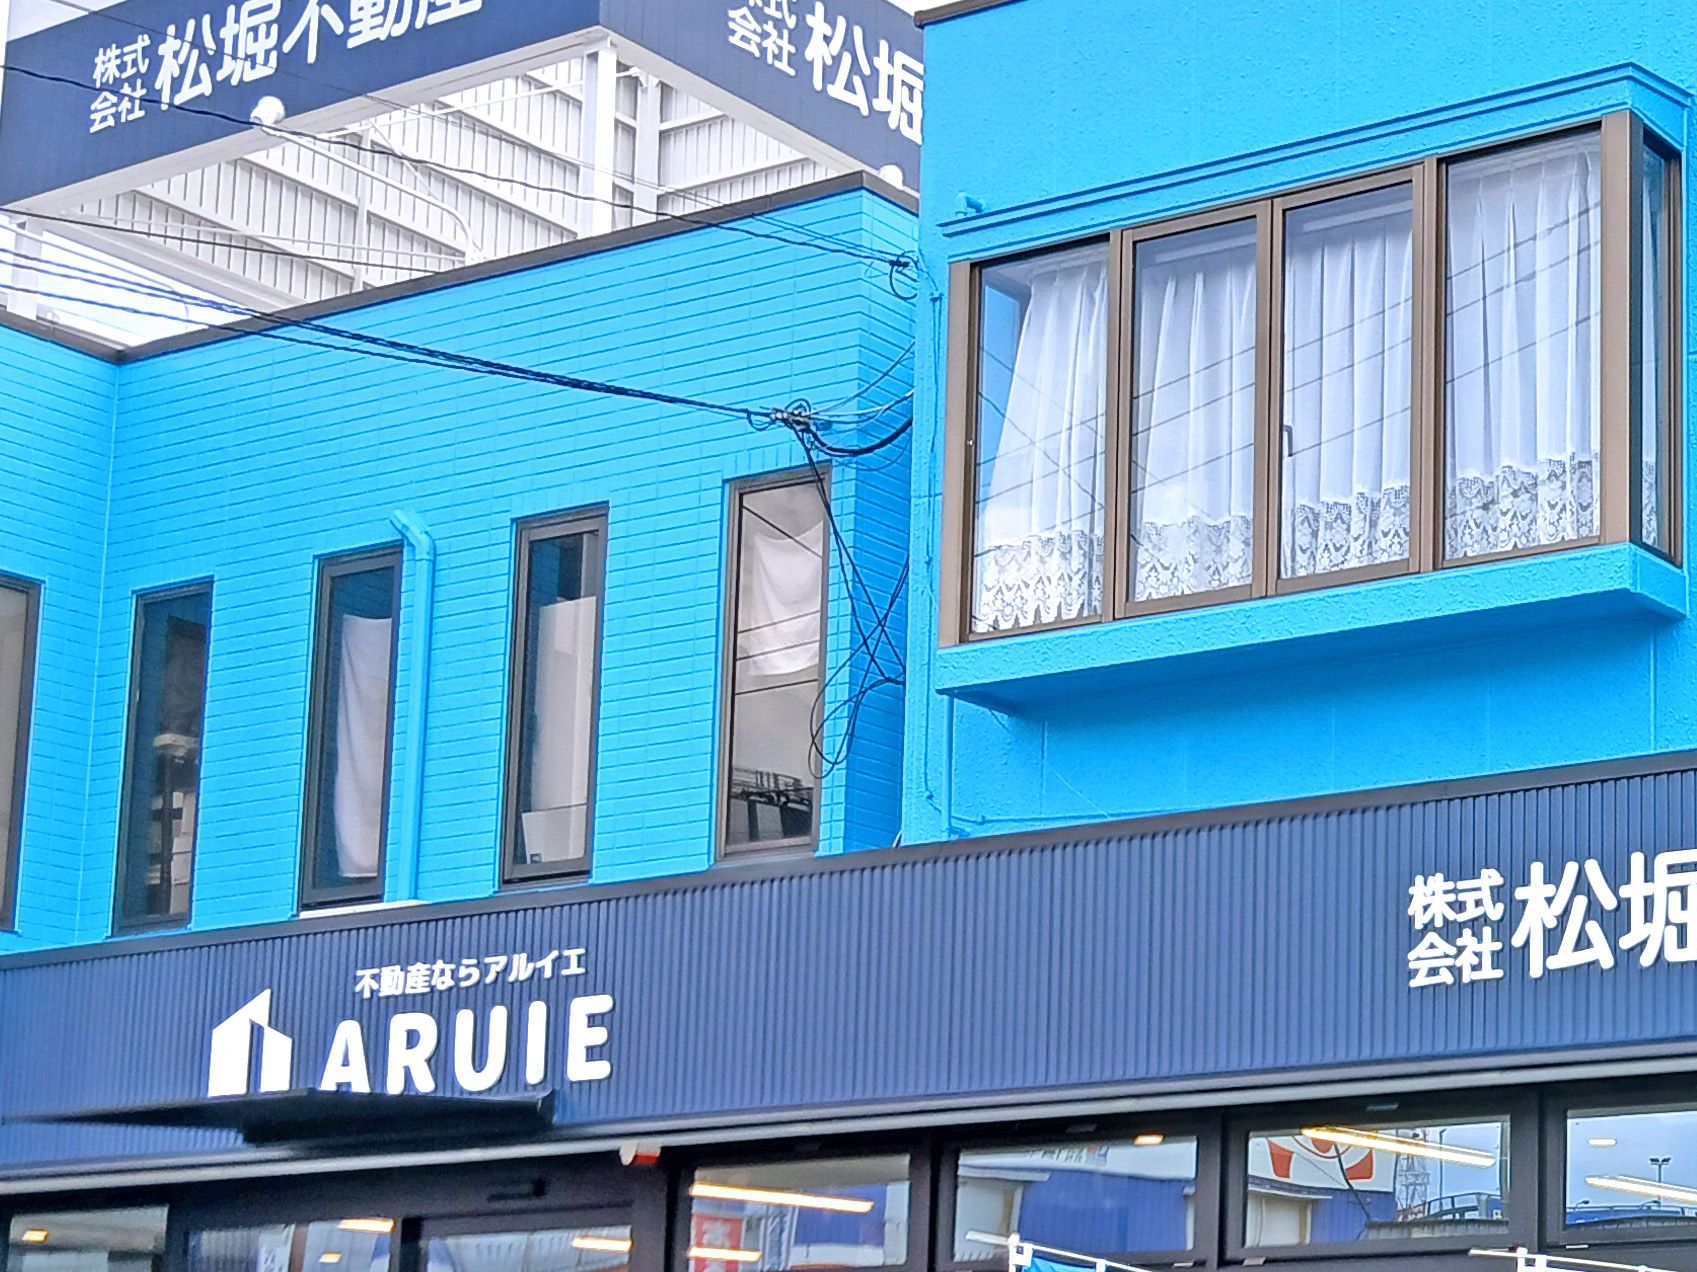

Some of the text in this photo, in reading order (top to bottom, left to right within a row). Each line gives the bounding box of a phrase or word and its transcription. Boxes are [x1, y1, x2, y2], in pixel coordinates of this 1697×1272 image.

[1407, 868, 1504, 930] 株式
[354, 947, 587, 1000] 不動産ならアルイエ
[1407, 925, 1504, 988] 会社
[319, 994, 615, 1095] ARUIE
